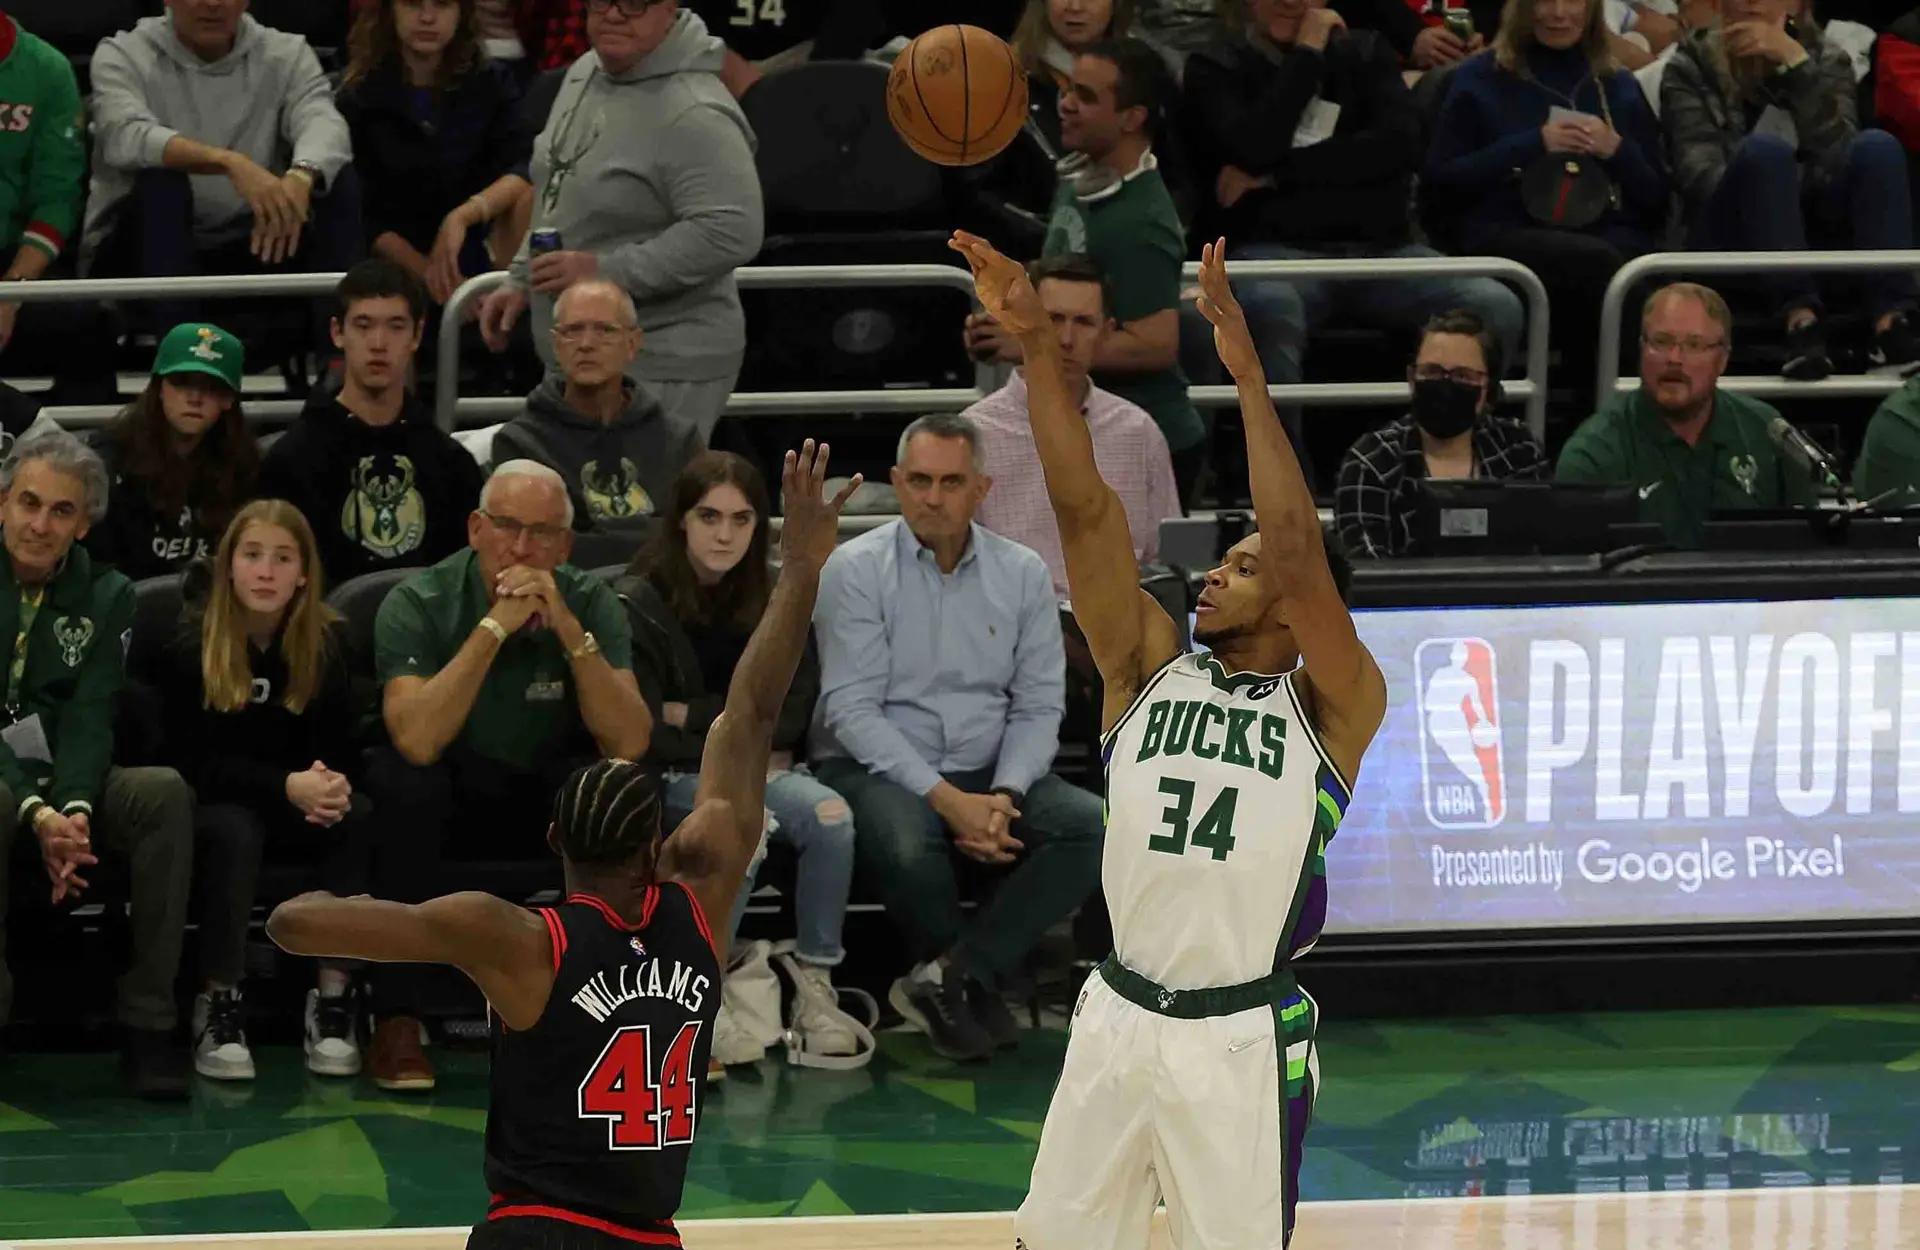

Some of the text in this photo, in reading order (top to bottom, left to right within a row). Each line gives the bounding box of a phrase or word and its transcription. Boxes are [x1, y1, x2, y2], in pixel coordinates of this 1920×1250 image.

[729, 0, 787, 26] 34
[1135, 699, 1287, 781] BUCKS
[1148, 776, 1239, 861] 34
[1436, 783, 1476, 816] NBA
[1431, 833, 1844, 893] Presented by Google Pixel
[571, 957, 710, 1023] WILLIAMS
[578, 1020, 703, 1150] 44
